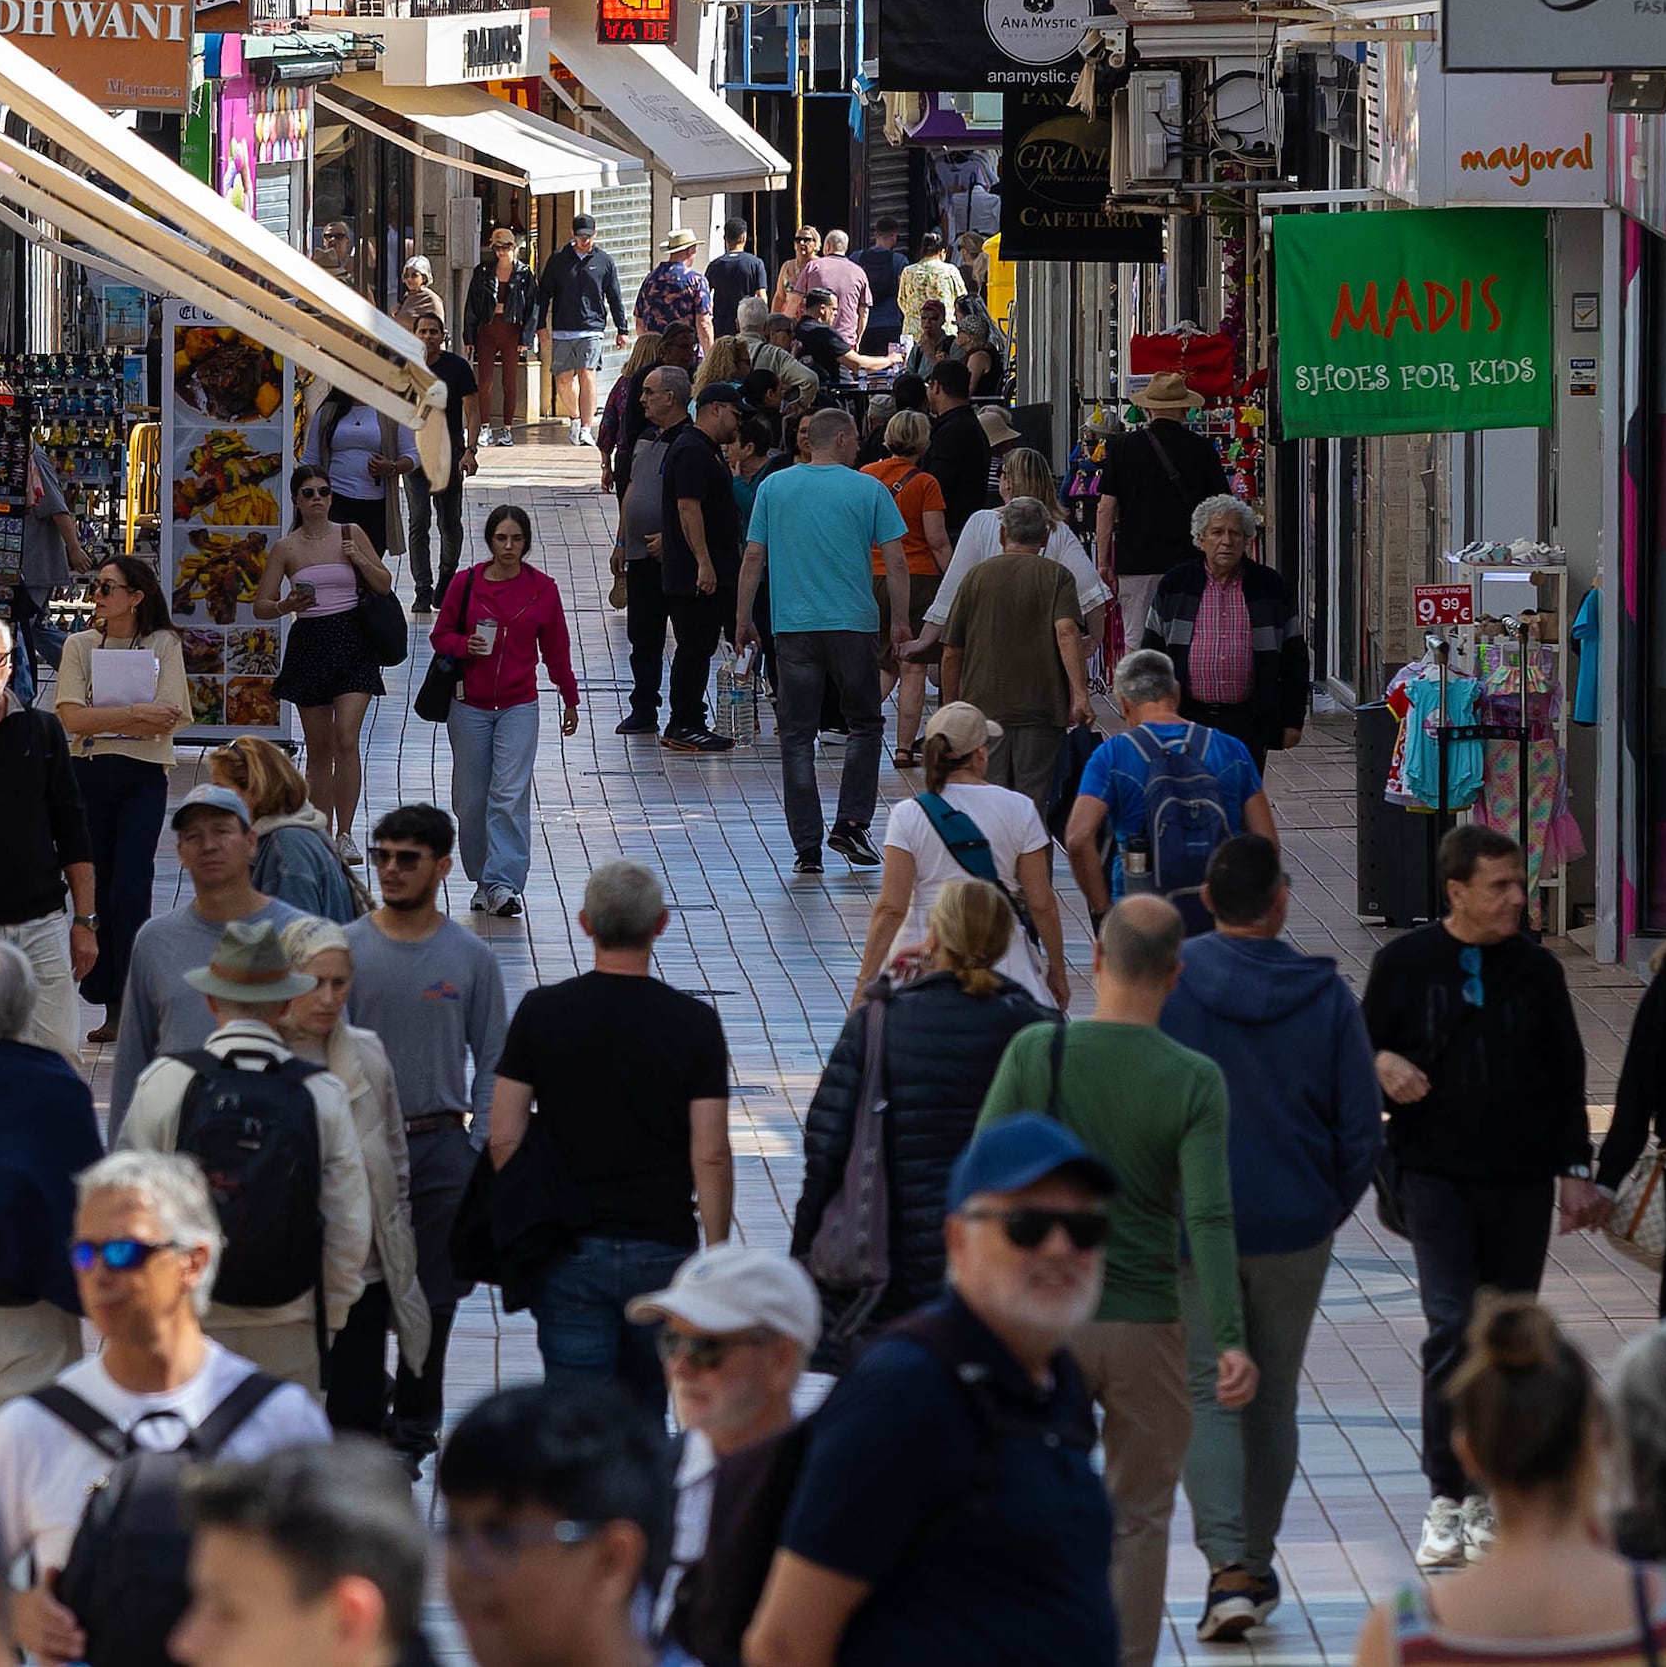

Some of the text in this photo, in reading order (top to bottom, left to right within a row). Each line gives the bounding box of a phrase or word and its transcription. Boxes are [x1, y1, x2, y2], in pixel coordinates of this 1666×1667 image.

[1460, 132, 1594, 186] mayoral
[1329, 274, 1502, 340] MADIS
[1295, 356, 1536, 396] SHOES FOR KIDS
